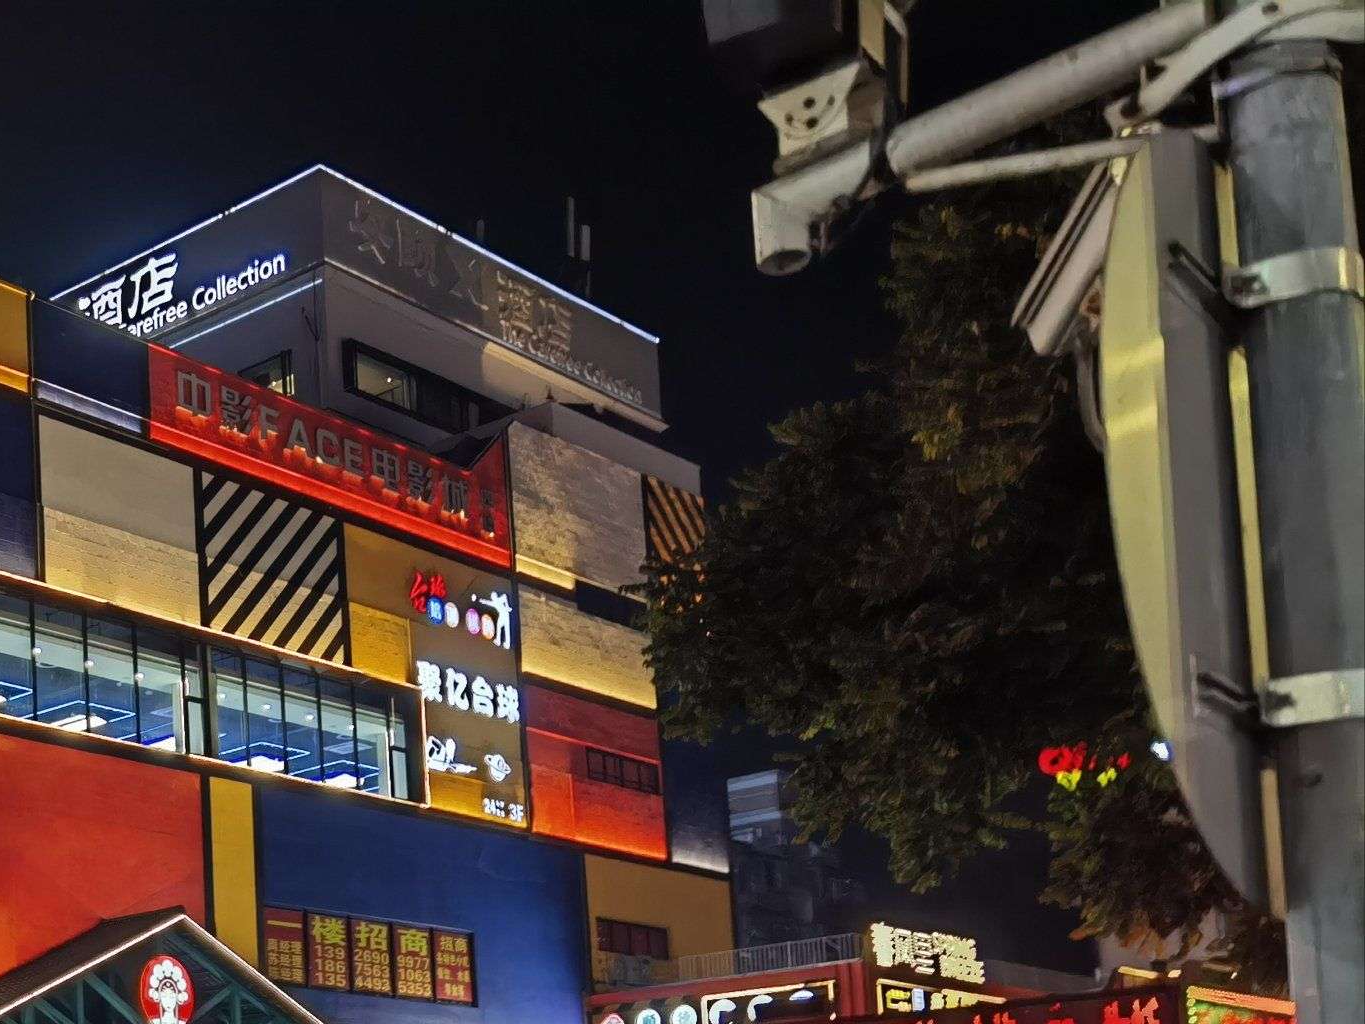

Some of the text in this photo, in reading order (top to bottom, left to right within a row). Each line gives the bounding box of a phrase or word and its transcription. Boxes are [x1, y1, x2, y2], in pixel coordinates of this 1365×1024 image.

[78, 251, 179, 326] 酒店
[118, 300, 189, 338] arefree
[191, 253, 286, 311] Collection
[267, 915, 429, 957] 一楼招商
[314, 944, 346, 961] 139
[353, 949, 390, 966] 2690
[314, 958, 347, 974] 186
[314, 971, 347, 987] 135
